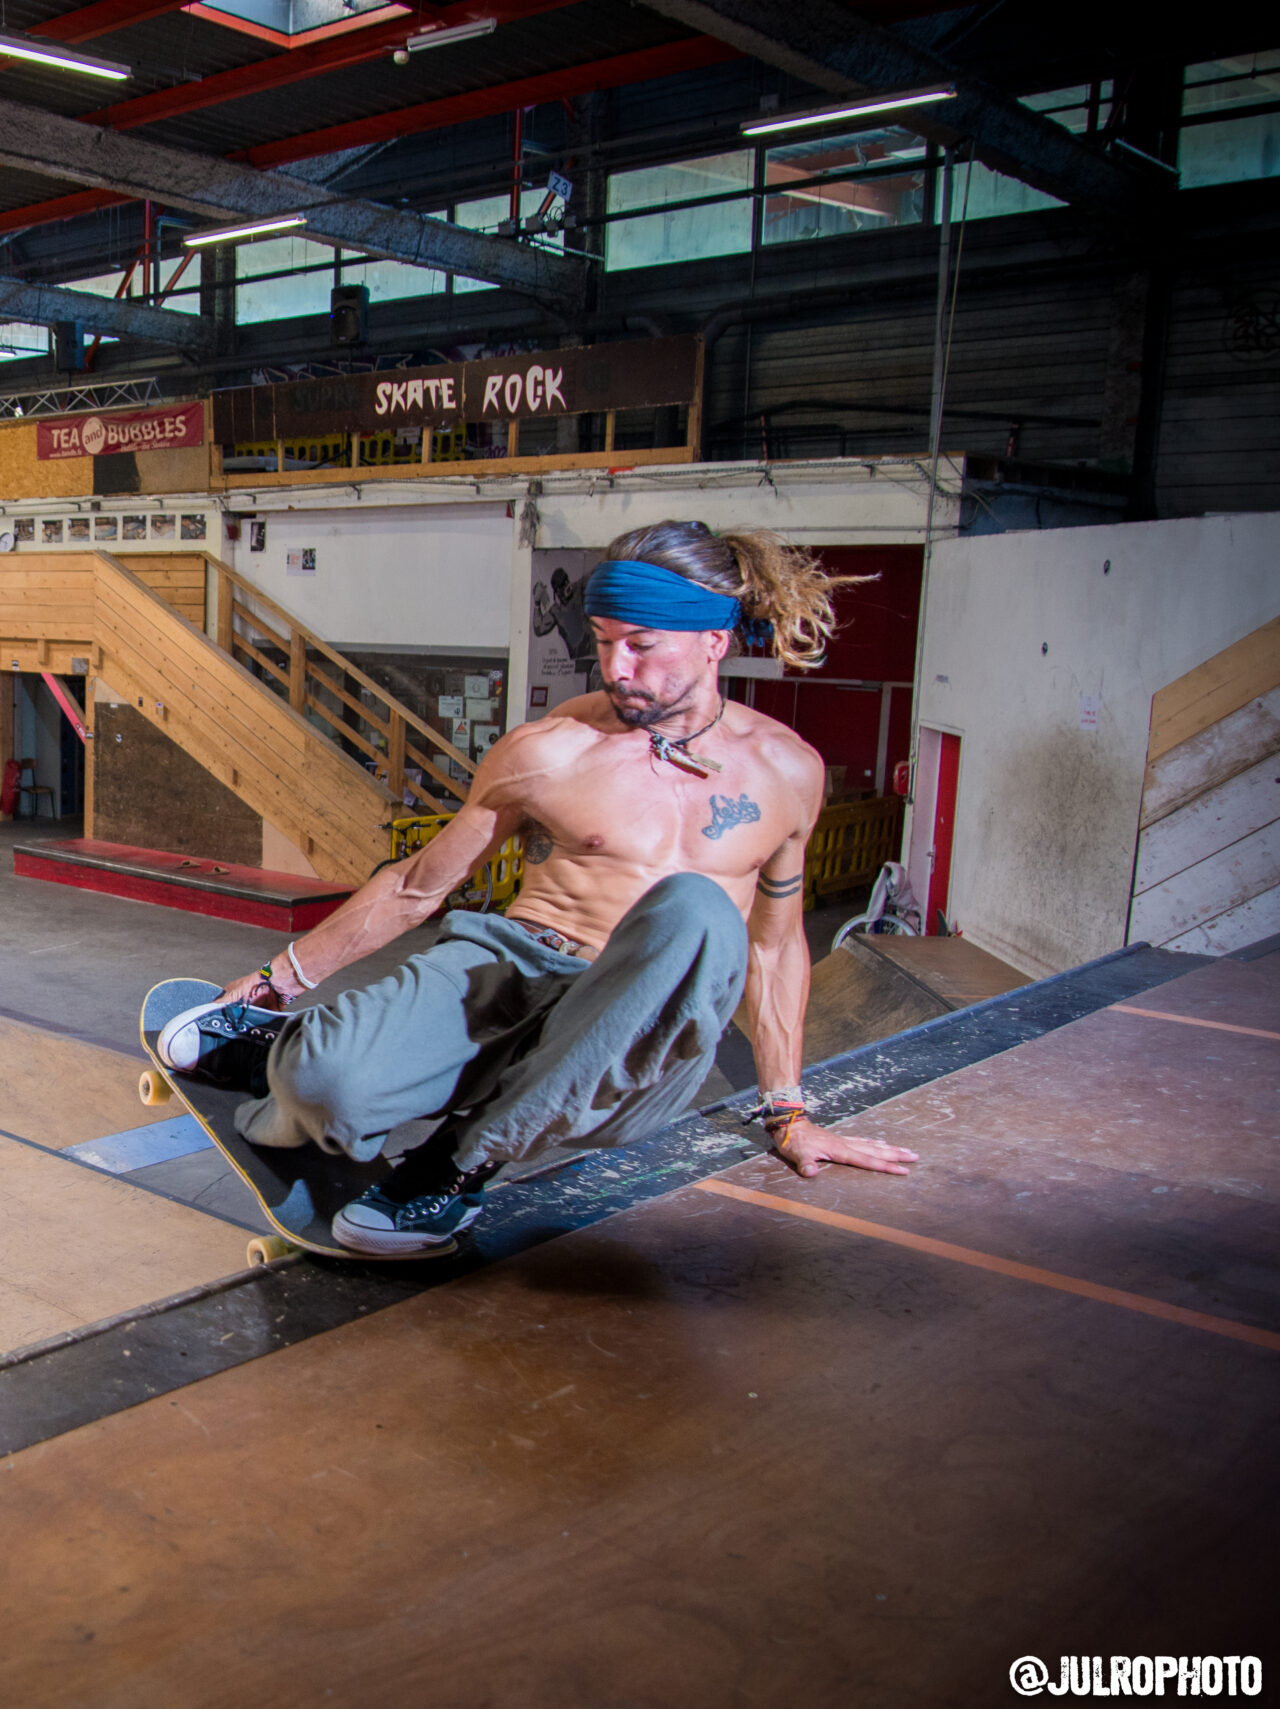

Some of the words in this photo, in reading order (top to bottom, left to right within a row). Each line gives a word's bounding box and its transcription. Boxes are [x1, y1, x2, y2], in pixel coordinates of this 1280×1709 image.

[375, 378, 457, 415] SKATE
[483, 365, 567, 414] ROCK
[51, 427, 80, 449] TEA
[84, 424, 103, 445] and
[107, 415, 187, 445] BUBBLES
